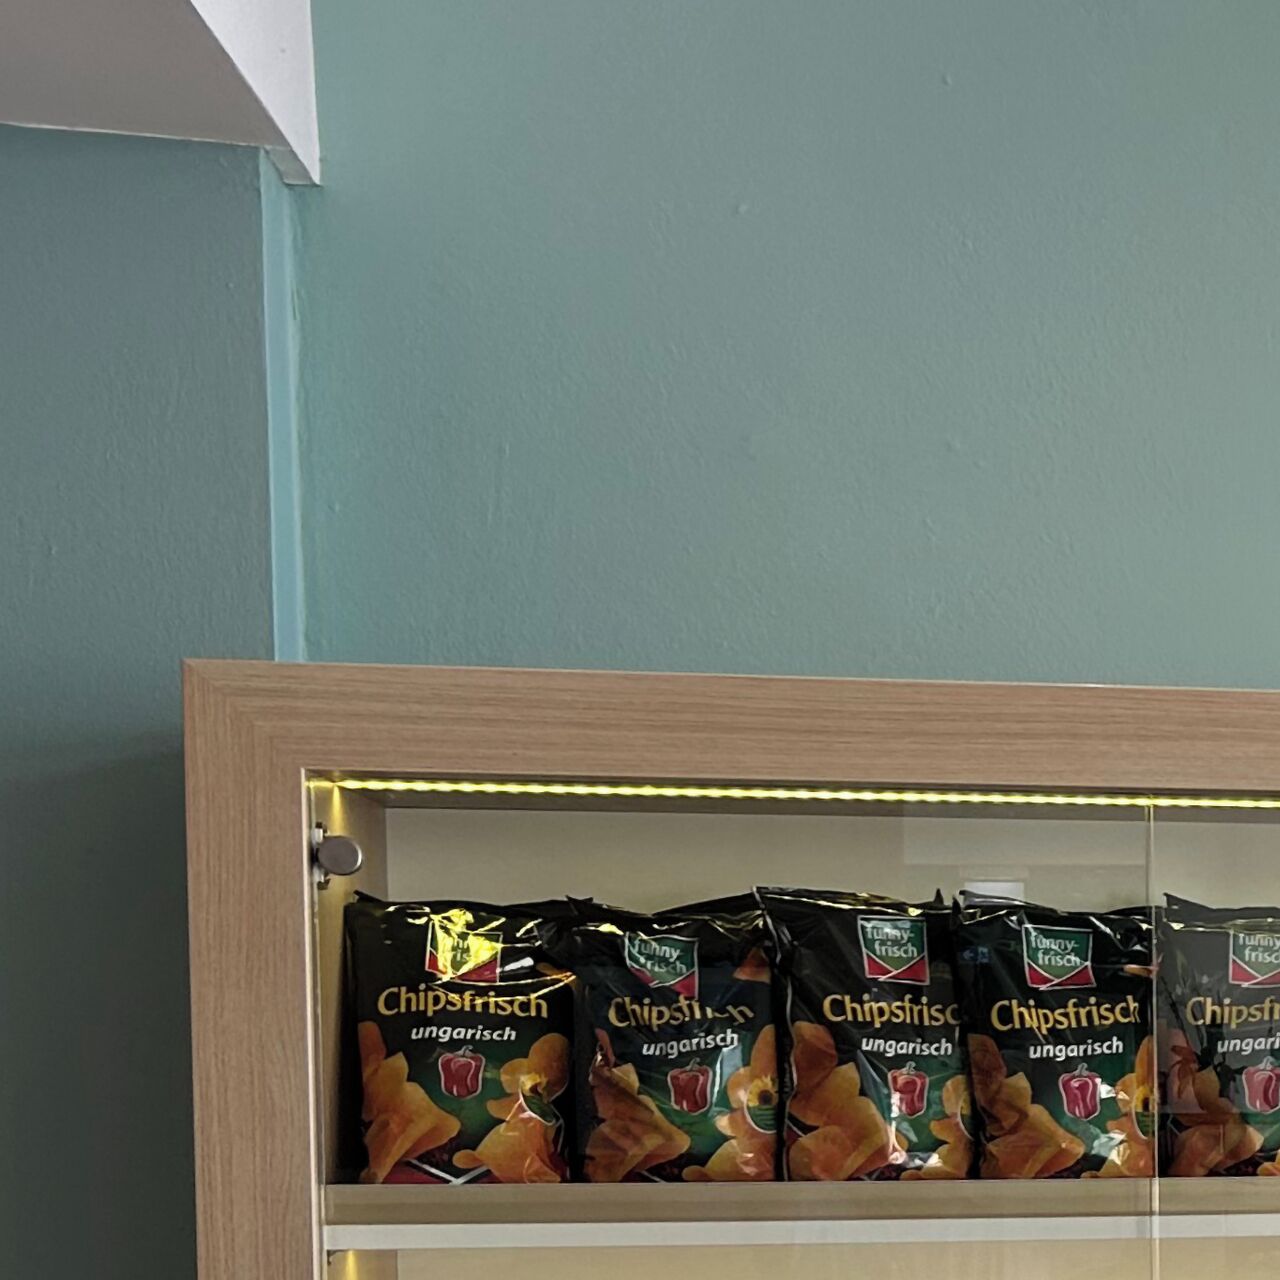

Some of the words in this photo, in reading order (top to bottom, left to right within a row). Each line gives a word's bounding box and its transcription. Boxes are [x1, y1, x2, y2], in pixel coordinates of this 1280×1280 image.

[874, 939, 918, 959] frisch
[1038, 949, 1082, 968] frisch
[377, 986, 548, 1018] Chipsfrisch
[822, 994, 961, 1028] Chipsfrisc
[990, 995, 1141, 1035] Chipsfrisch
[411, 1025, 517, 1042] ungarisch
[642, 1028, 739, 1060] ungarisch
[861, 1036, 953, 1057] ungarisch
[1029, 1036, 1124, 1060] ungarisch
